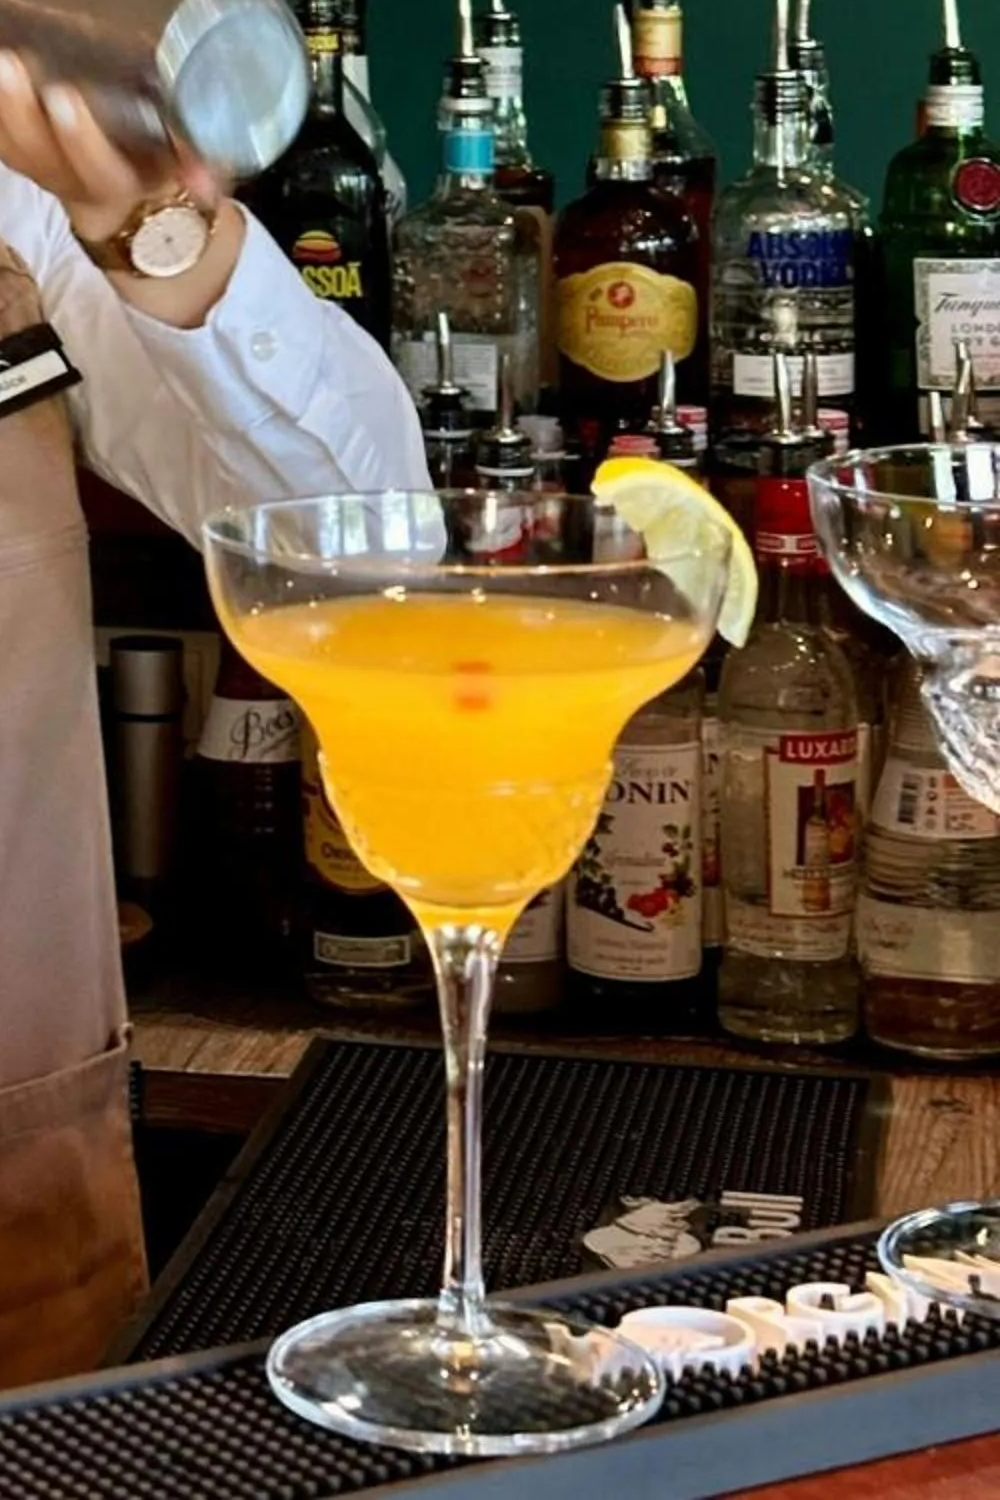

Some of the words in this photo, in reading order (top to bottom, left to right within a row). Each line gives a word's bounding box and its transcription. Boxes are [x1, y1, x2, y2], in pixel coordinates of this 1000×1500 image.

[301, 261, 364, 298] SSOÃ
[584, 304, 661, 339] Pampero
[785, 738, 857, 760] LUXAR
[605, 780, 691, 804] ONIN
